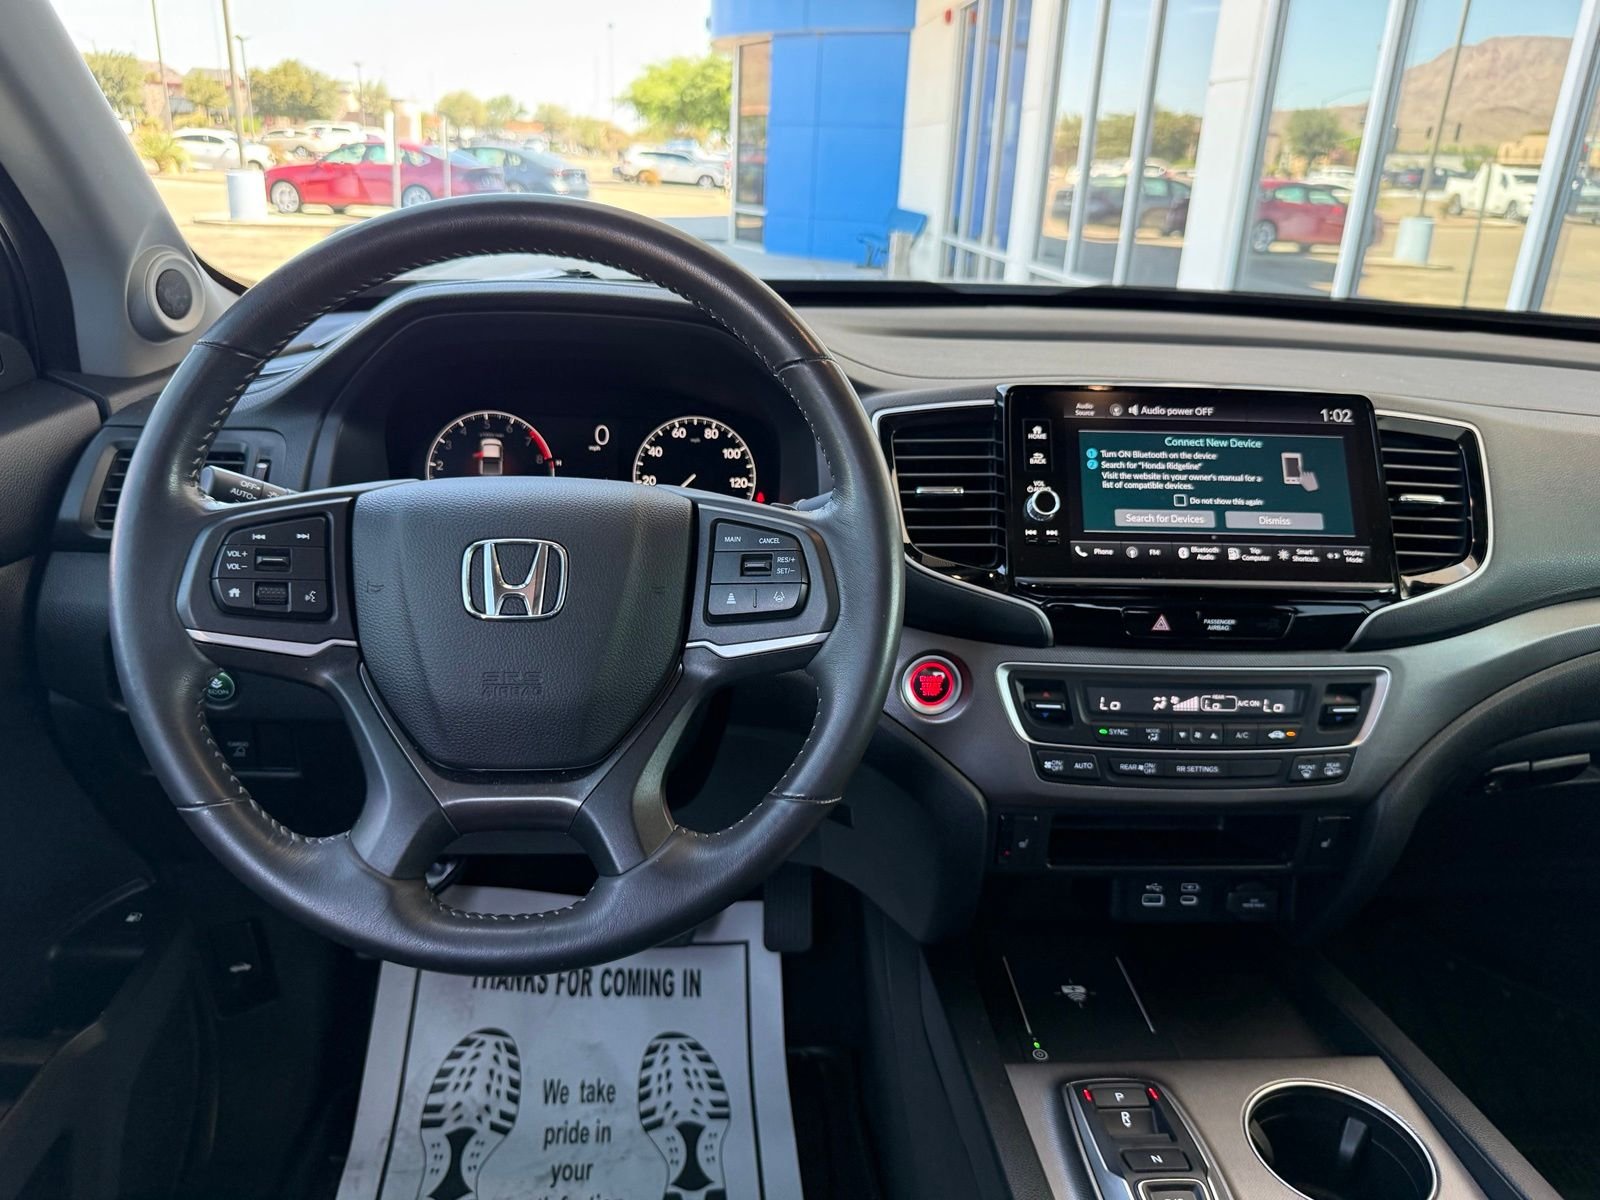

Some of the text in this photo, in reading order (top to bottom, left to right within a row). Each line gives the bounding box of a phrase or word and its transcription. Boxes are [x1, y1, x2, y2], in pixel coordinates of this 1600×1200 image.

[1075, 402, 1094, 410] Audio
[1140, 405, 1214, 417] Audio power OFF
[1075, 409, 1096, 417] Source
[1320, 408, 1353, 423] 1:02
[483, 420, 491, 430] 5
[506, 424, 514, 434] 6
[460, 427, 467, 436] 4
[594, 424, 610, 446] 0
[671, 427, 687, 439] 60
[704, 428, 719, 440] 80
[1027, 432, 1048, 440] HOME
[445, 441, 453, 450] 3
[1164, 436, 1263, 448] Connect New Device
[648, 446, 663, 458] 40
[722, 448, 741, 460] 100
[1101, 450, 1117, 459] Turn
[1117, 450, 1132, 459] ON
[1132, 450, 1168, 459] Bluetooth
[1168, 452, 1179, 460] on
[1179, 451, 1192, 460] the
[1193, 452, 1217, 461] device
[436, 460, 445, 471] 2
[1029, 457, 1047, 465] BACK
[1101, 461, 1125, 470] Search
[1126, 461, 1138, 470] for
[1138, 462, 1166, 470] "Honda
[641, 475, 657, 486] 20
[1101, 471, 1119, 480] Visit
[1119, 472, 1132, 480] the
[1132, 472, 1161, 481] website
[1162, 472, 1170, 480] in
[1170, 474, 1189, 482] your
[1188, 473, 1217, 482] owner's
[1217, 474, 1244, 483] manual
[1244, 475, 1255, 483] for
[240, 480, 257, 490] OFF
[729, 477, 748, 489] 120
[1102, 481, 1195, 490] list of compatible devices.
[230, 487, 254, 500] AUTO
[1189, 497, 1201, 505] Do
[1232, 498, 1245, 506] this
[1245, 499, 1264, 507] again
[1125, 513, 1205, 524] Search for Devices
[1258, 515, 1291, 526] Dismiss
[1093, 547, 1115, 556] Phone
[1190, 546, 1220, 554] Bluetooth
[1249, 546, 1261, 555] Trip
[1295, 548, 1314, 556] Smart
[1342, 549, 1365, 558] Display
[1196, 553, 1216, 561] Audio
[1241, 554, 1271, 562] Computer
[1291, 555, 1320, 563] Shortcuts
[1345, 556, 1364, 564] Mode
[1099, 696, 1122, 711] Lo
[1263, 698, 1285, 713] Lo
[1108, 728, 1129, 736] SYNC
[1235, 731, 1249, 739] A/C
[1073, 762, 1094, 770] AUTO
[1119, 763, 1137, 771] REAR
[1186, 765, 1219, 773] SETTINGS
[555, 968, 593, 997] FOR
[600, 967, 676, 998] COMING
[682, 968, 702, 998] IN
[543, 1077, 617, 1105] We take
[1114, 1091, 1125, 1102] P
[1120, 1111, 1132, 1125] R
[543, 1118, 612, 1151] pride in
[1150, 1154, 1163, 1164] N
[549, 1162, 594, 1189] your
